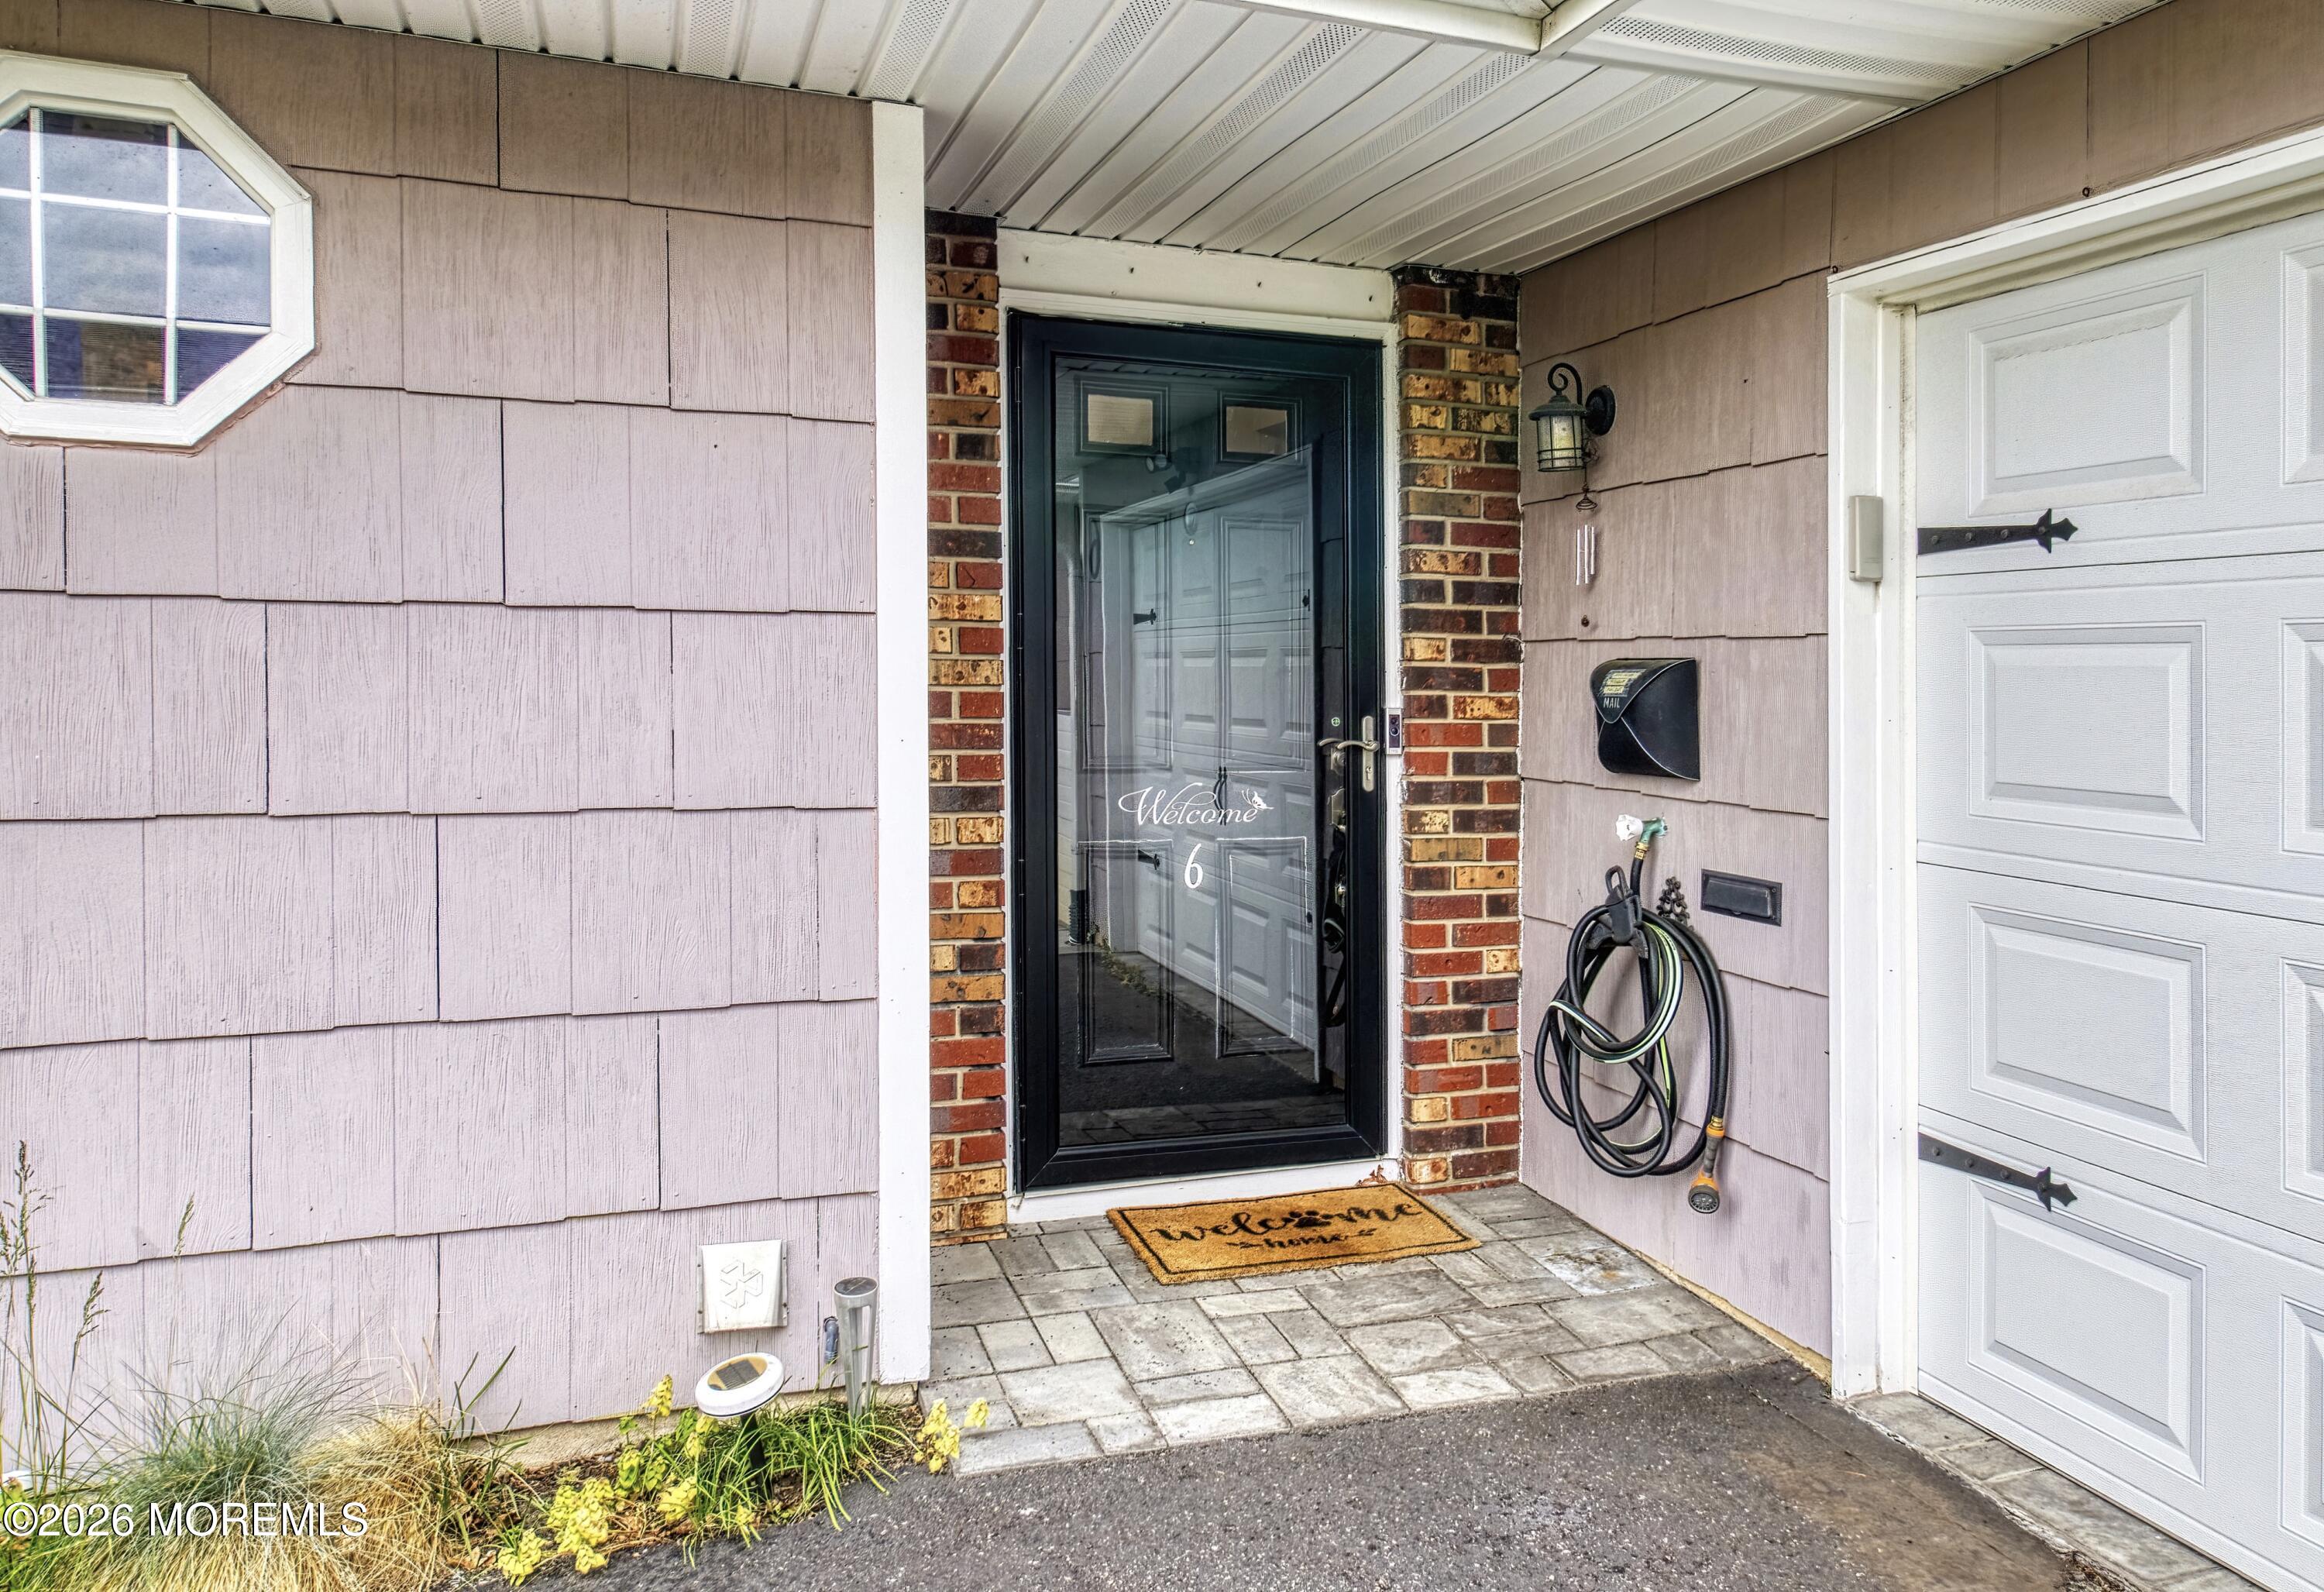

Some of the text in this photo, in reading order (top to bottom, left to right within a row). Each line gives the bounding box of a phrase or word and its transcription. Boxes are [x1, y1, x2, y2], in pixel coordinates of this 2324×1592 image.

[1604, 697, 1620, 708] MAIL
[1118, 782, 1258, 826] Welcome
[1184, 843, 1204, 889] 6
